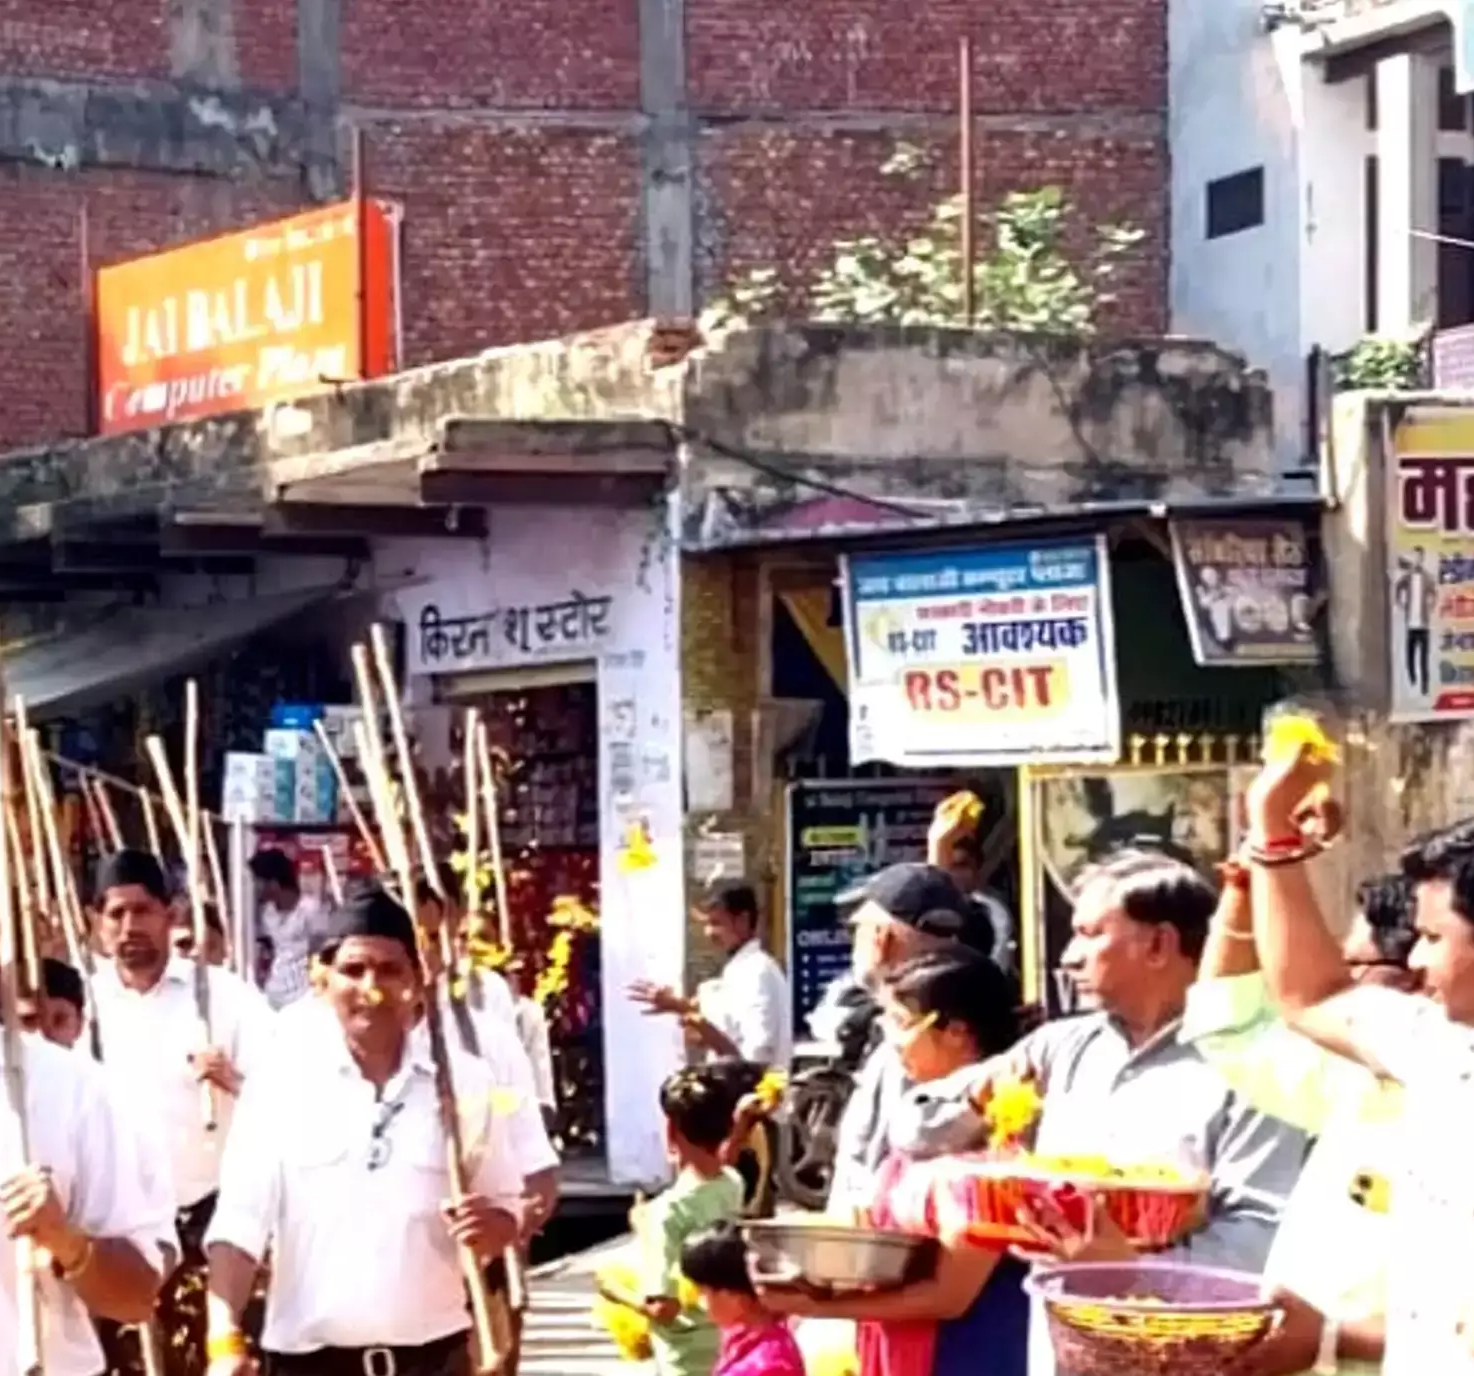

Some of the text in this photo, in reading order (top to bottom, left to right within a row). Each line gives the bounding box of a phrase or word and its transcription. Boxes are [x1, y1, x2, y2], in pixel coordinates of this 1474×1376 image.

[122, 261, 324, 366] JAI BALAJI
[104, 363, 253, 421] Computer
[534, 590, 614, 642] स्टोर
[961, 616, 1089, 655] आवश्यक
[904, 664, 1054, 712] RS-CIT
